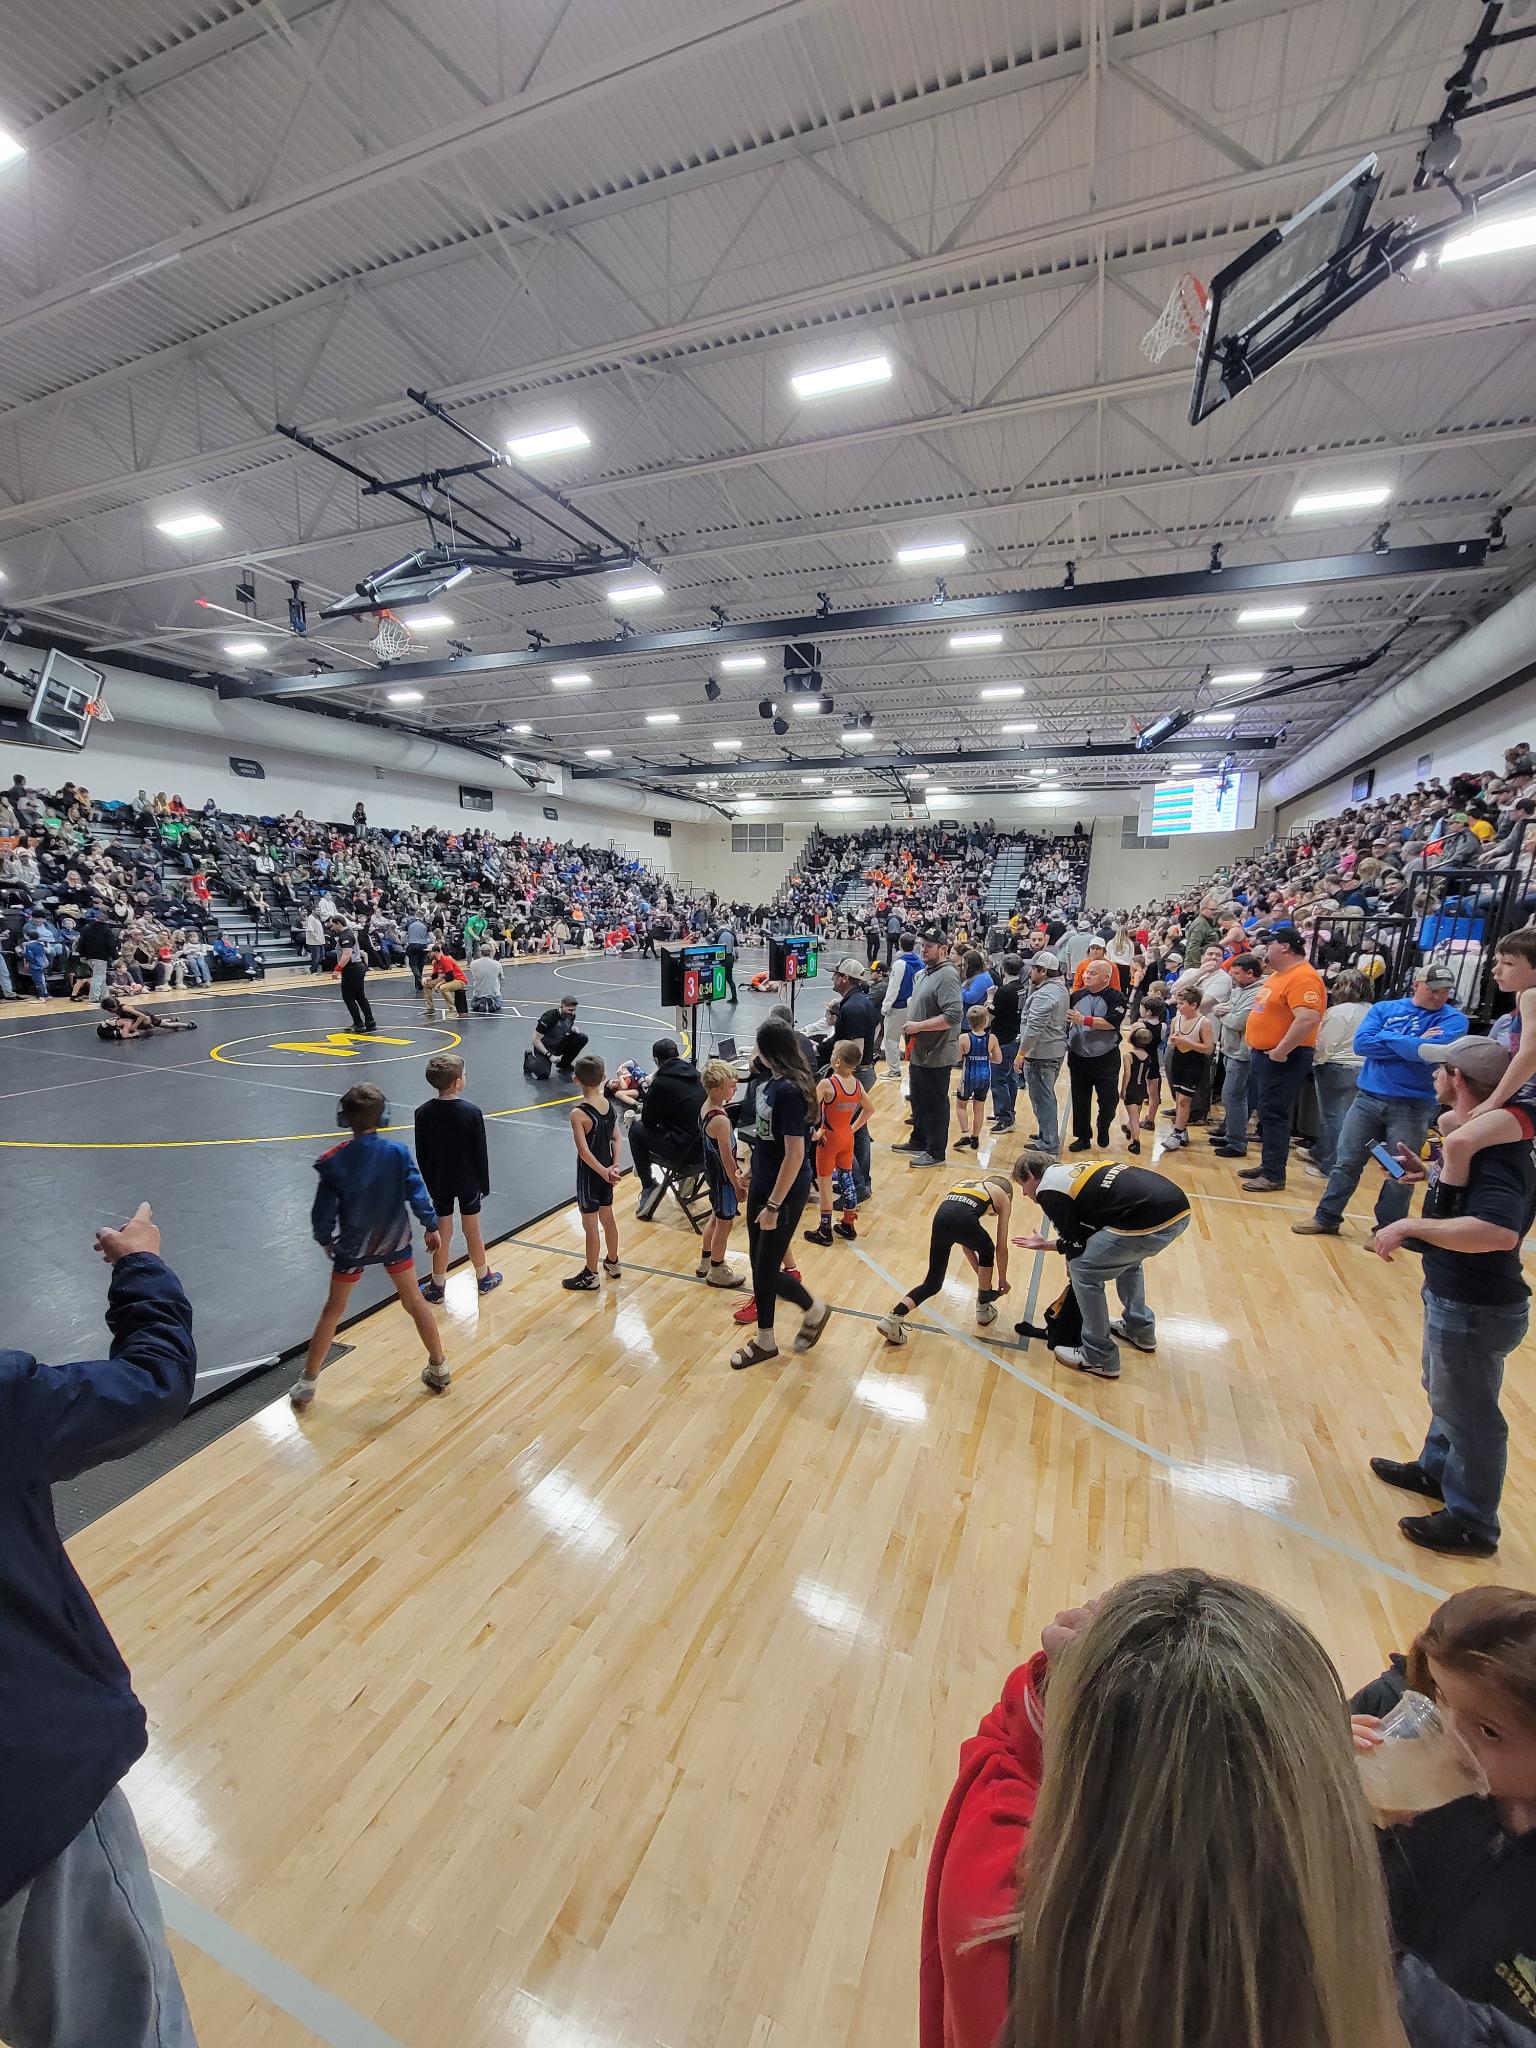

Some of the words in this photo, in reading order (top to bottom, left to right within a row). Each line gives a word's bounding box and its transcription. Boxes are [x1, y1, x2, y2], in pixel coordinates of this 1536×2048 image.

[788, 959, 794, 976] 3
[809, 957, 815, 972] 0
[687, 976, 695, 998] 3
[716, 972, 722, 992] 0
[681, 1009, 688, 1030] 8
